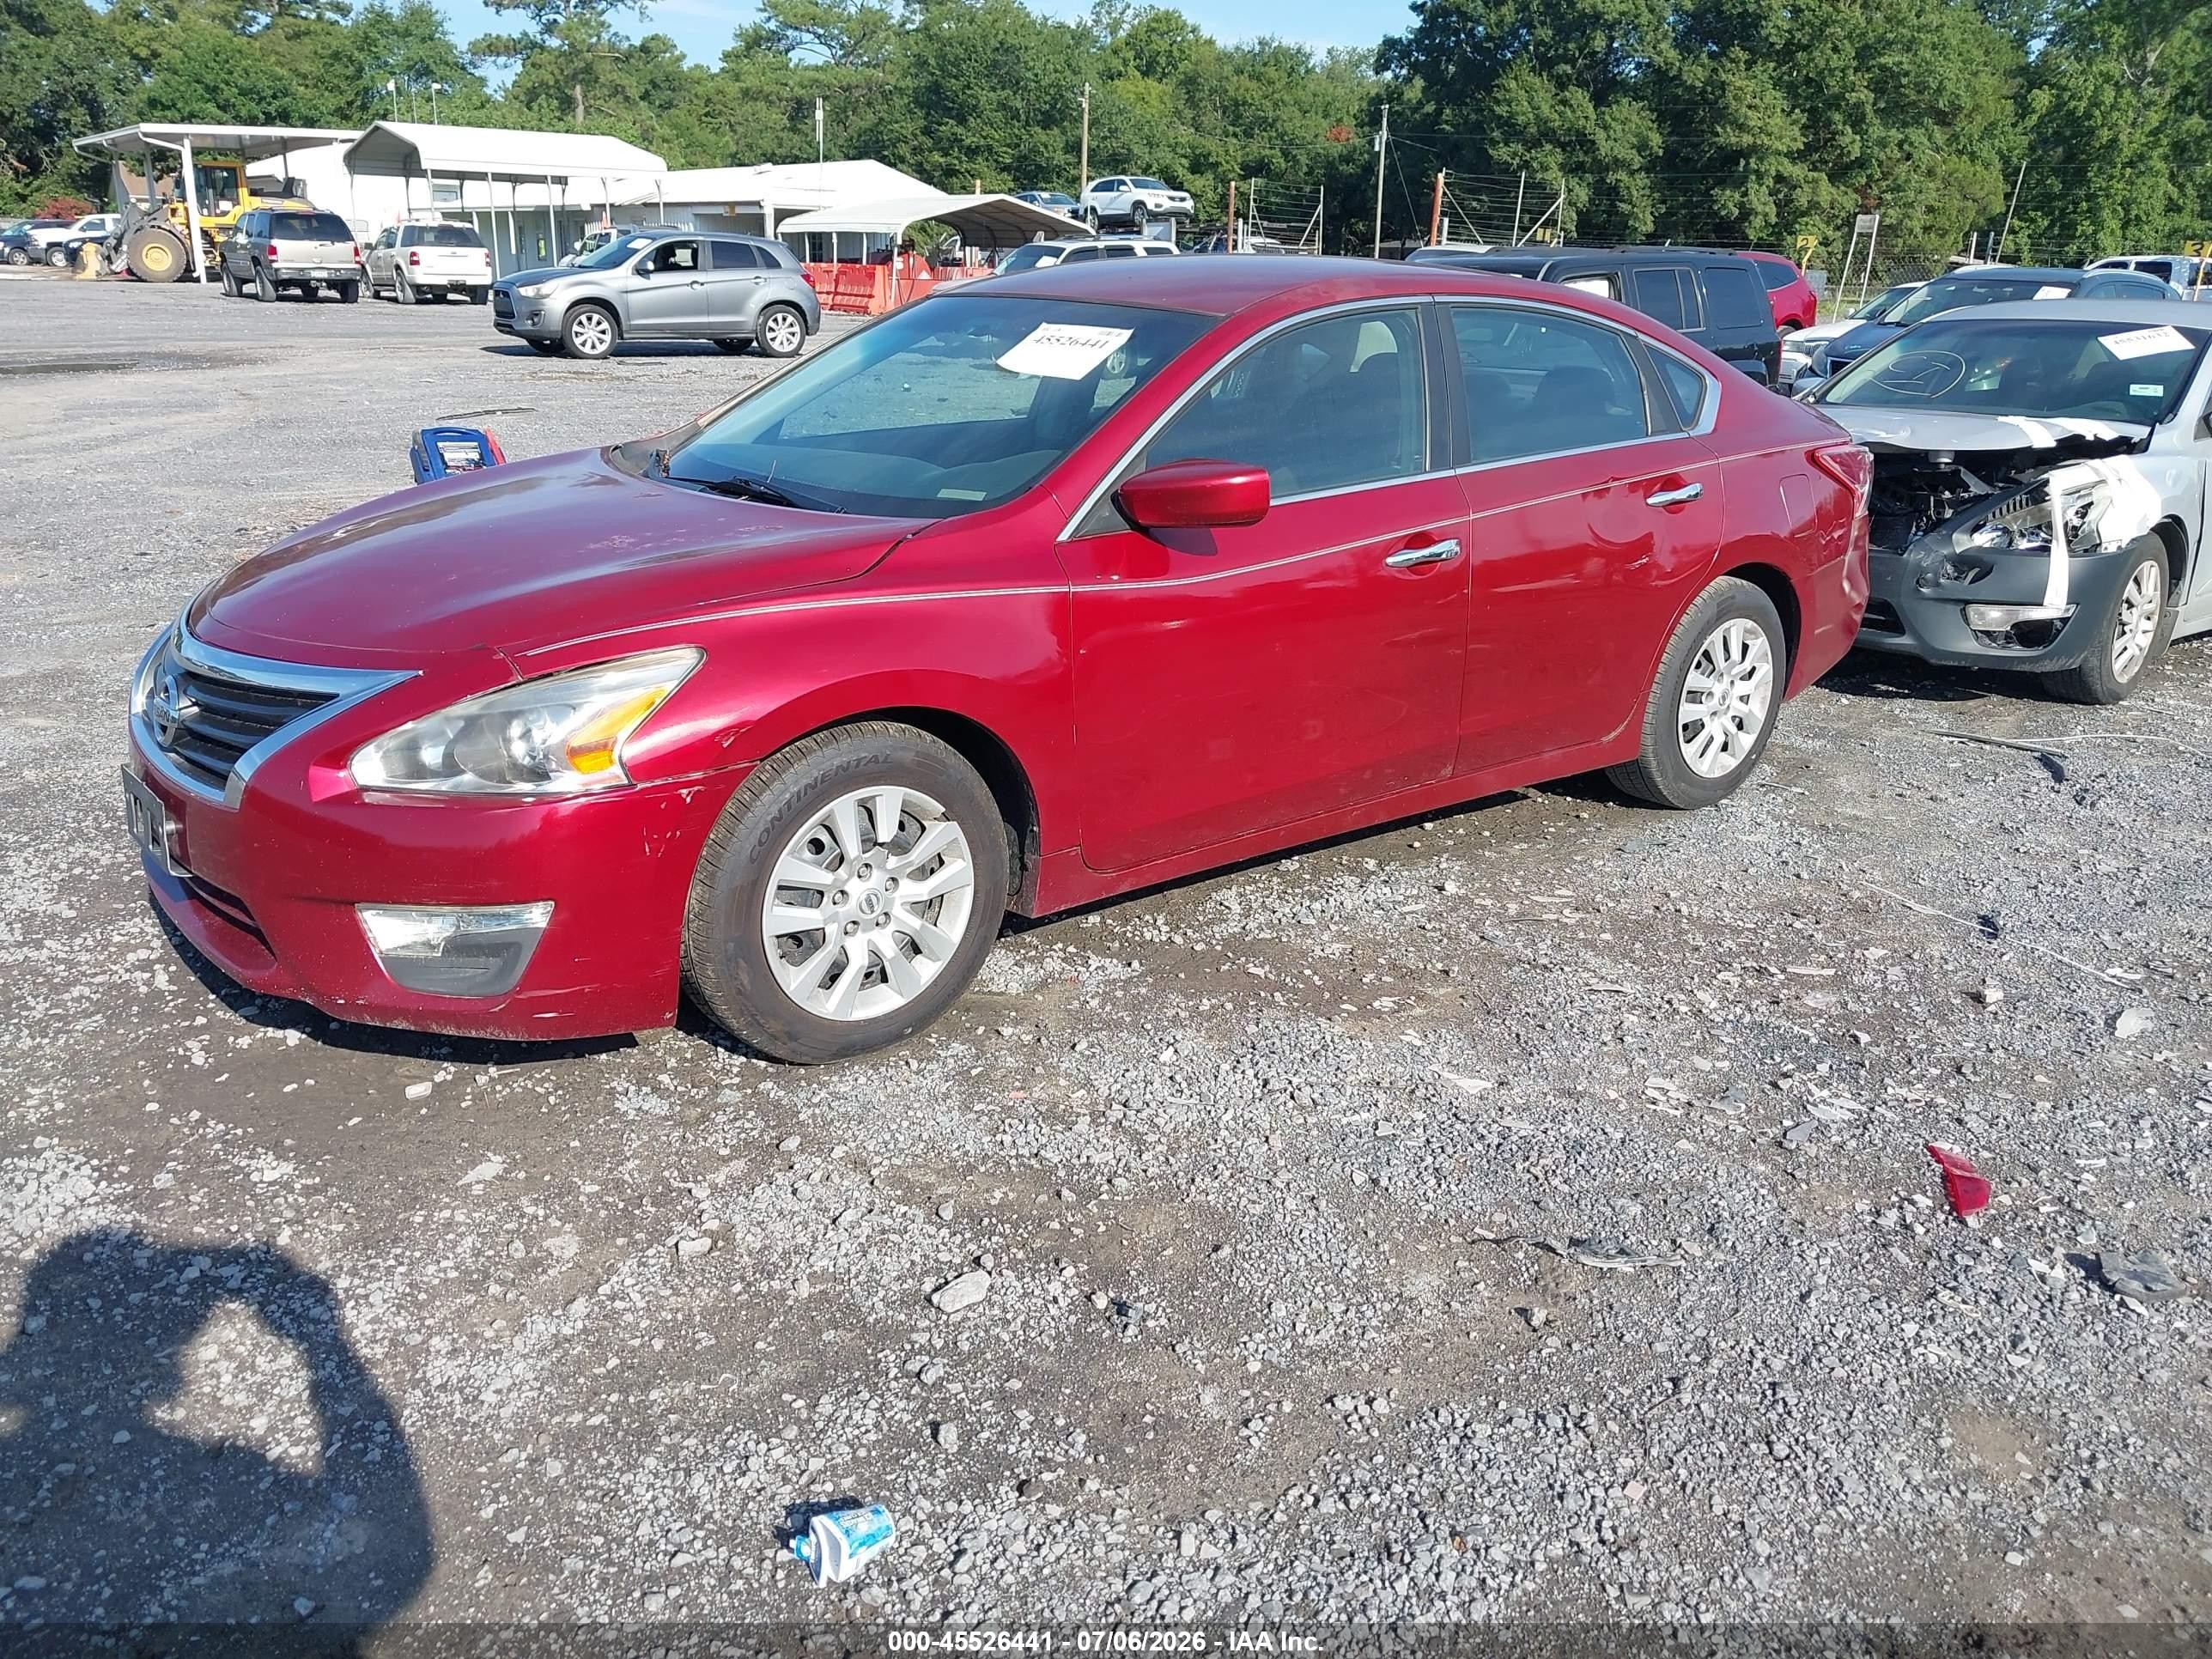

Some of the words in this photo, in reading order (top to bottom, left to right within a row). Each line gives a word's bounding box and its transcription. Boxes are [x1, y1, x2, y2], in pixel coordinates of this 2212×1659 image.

[2191, 242, 2204, 257] 3
[1033, 335, 1109, 349] 45526441
[750, 753, 893, 864] CONTINENTAL
